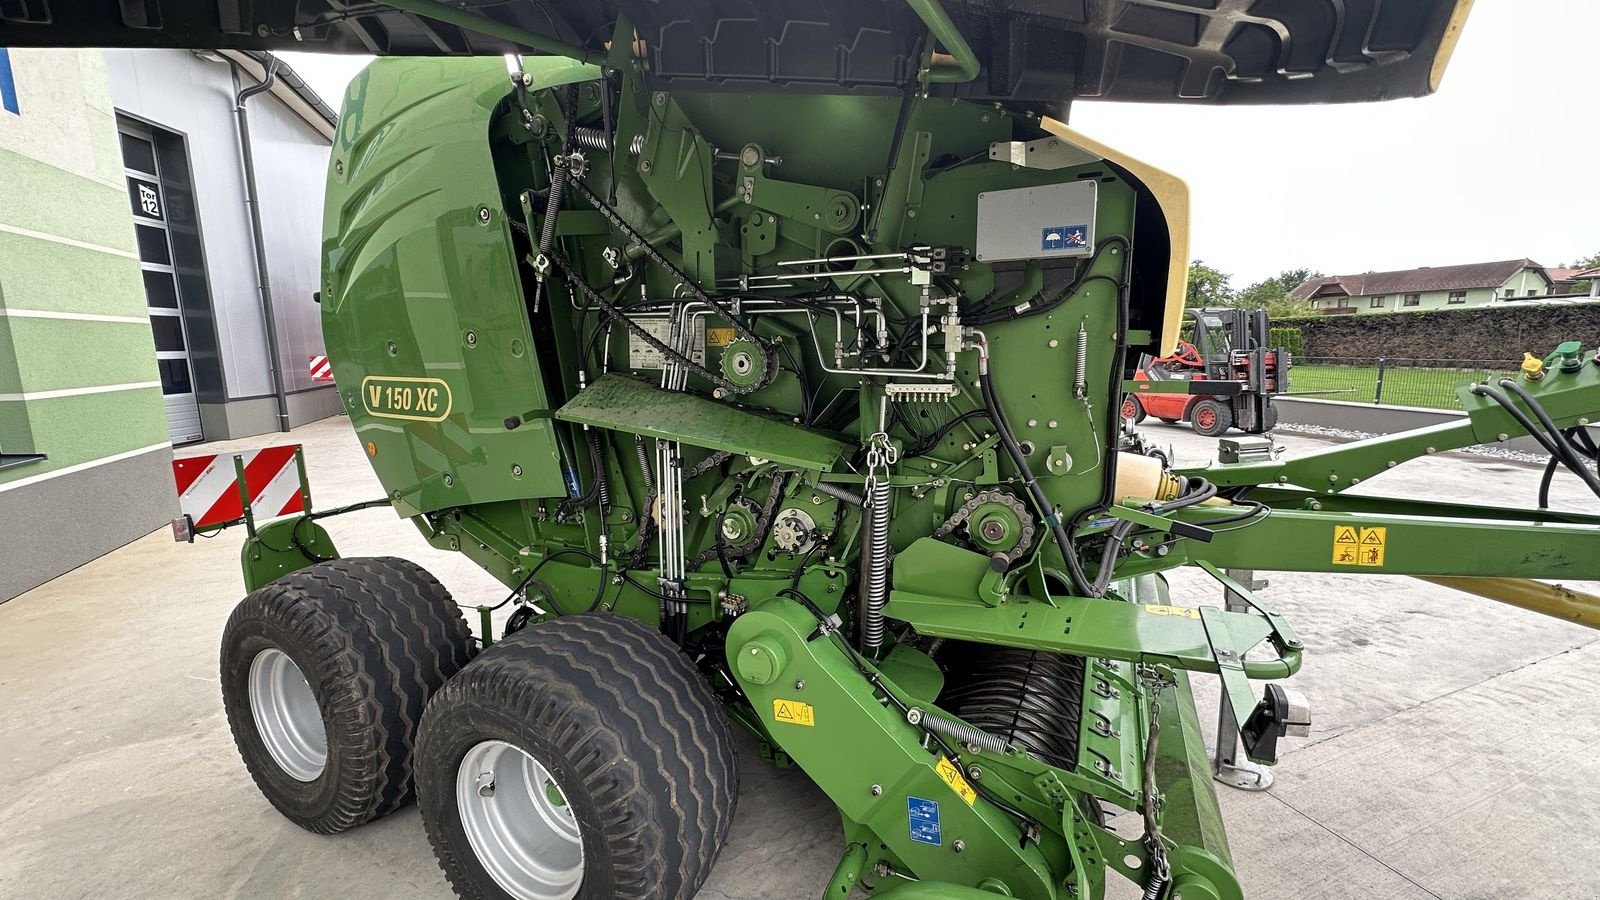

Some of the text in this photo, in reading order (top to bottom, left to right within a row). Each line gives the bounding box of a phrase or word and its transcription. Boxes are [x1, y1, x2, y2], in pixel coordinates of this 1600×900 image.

[141, 190, 155, 200] Tor
[143, 200, 158, 213] 12
[369, 385, 439, 412] V 150 XC
